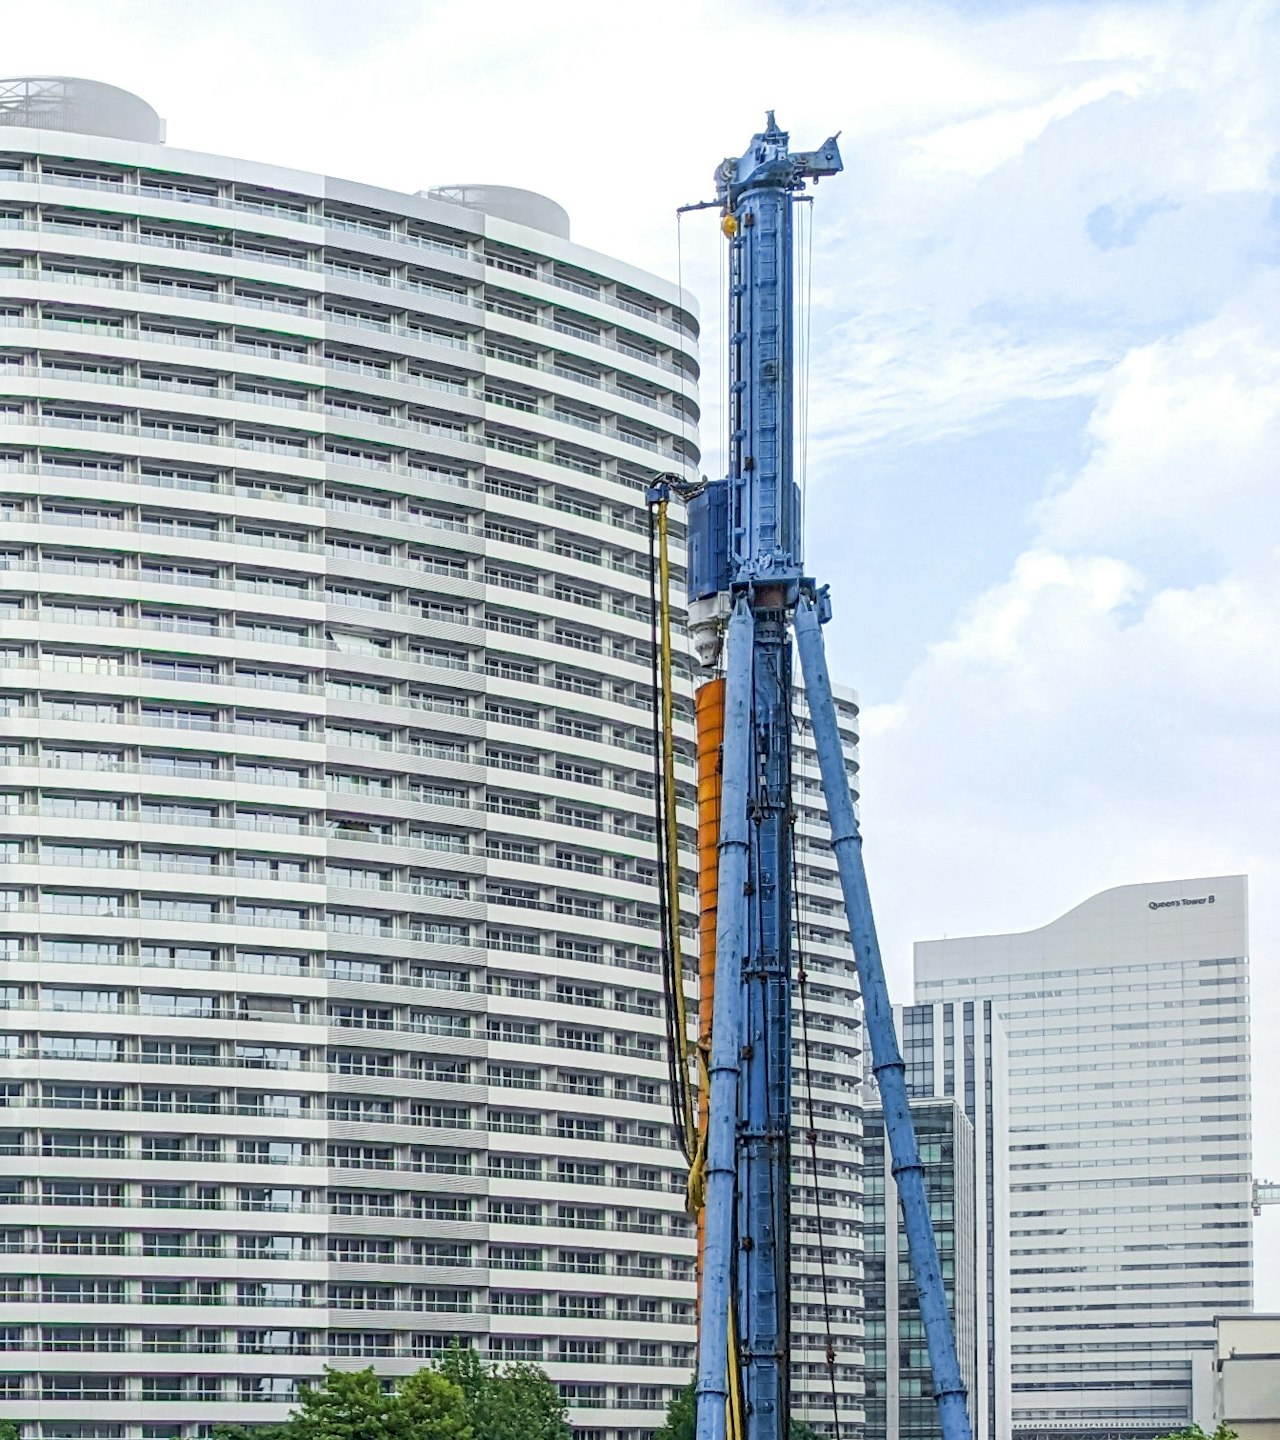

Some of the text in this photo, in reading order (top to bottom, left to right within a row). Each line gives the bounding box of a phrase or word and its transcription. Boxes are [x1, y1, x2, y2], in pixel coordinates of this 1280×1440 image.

[1148, 895, 1215, 910] Queen's Tower B
